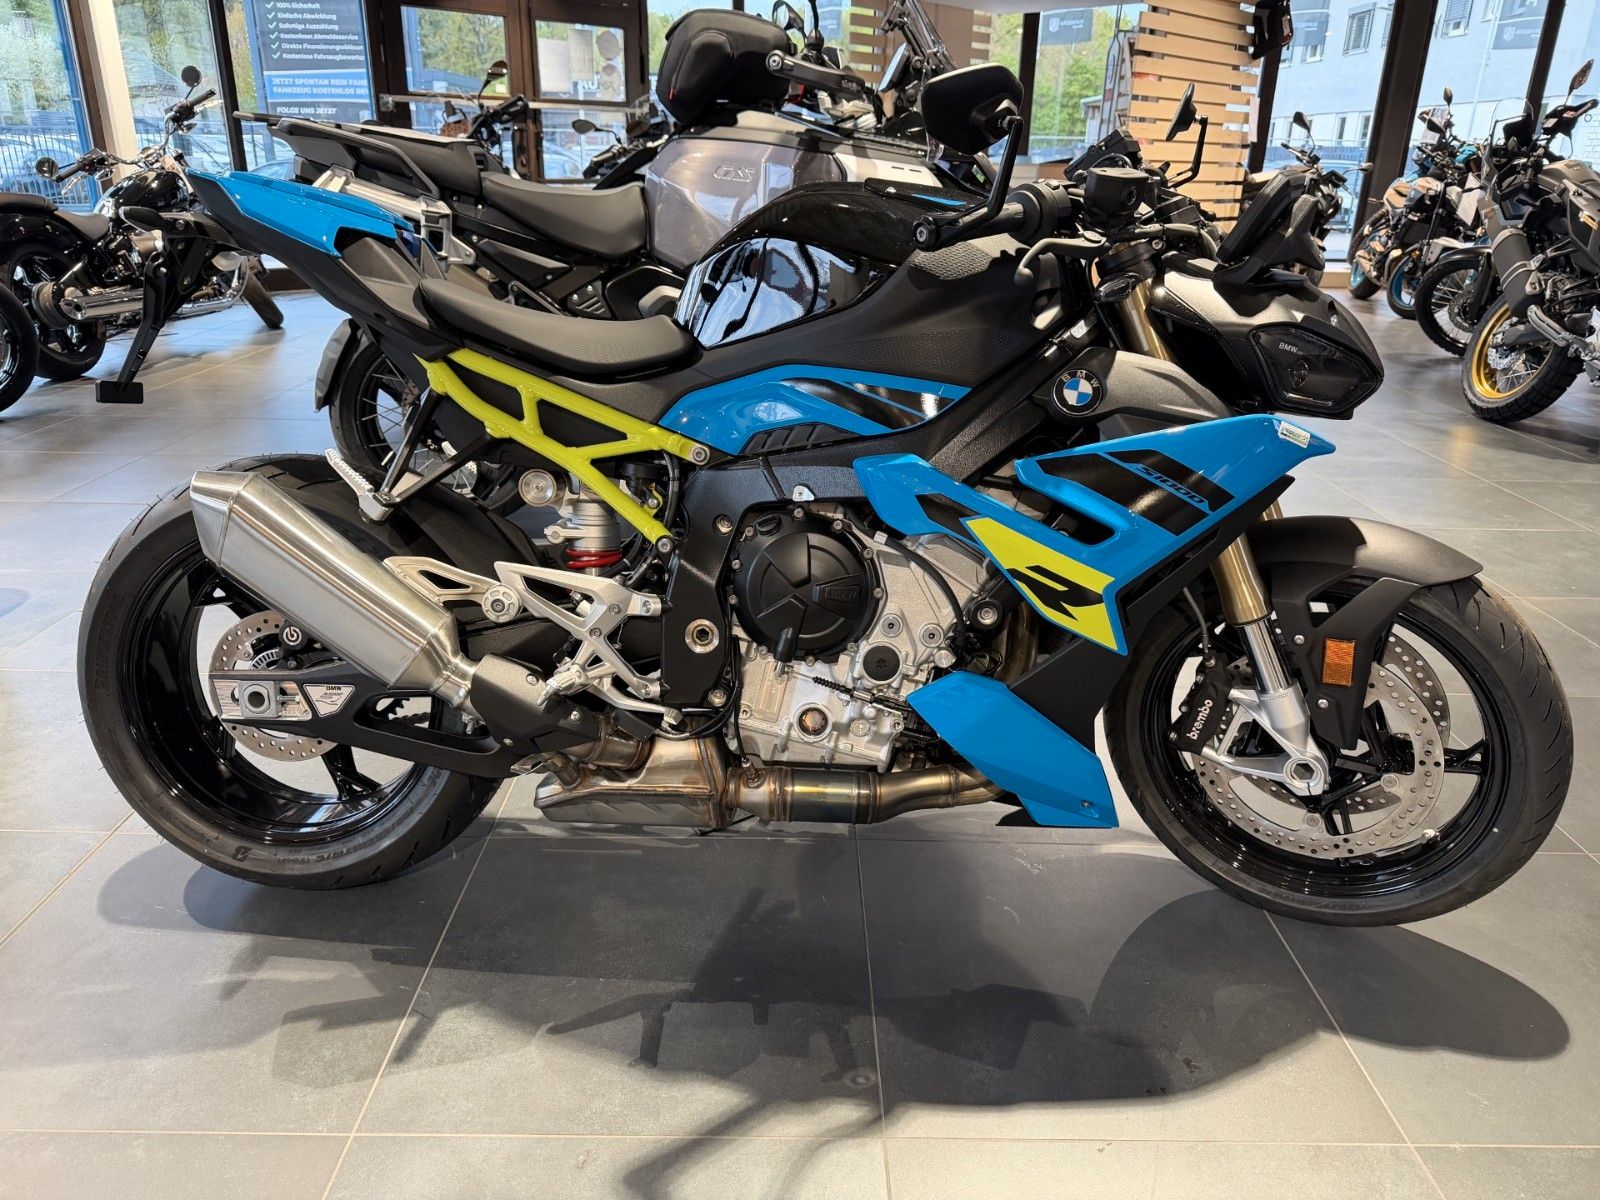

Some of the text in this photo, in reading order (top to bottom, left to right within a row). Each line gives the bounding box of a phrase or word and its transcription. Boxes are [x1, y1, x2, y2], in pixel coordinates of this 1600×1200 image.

[1278, 341, 1298, 354] BMW
[1061, 370, 1100, 388] BMW
[1186, 699, 1214, 741] brembo
